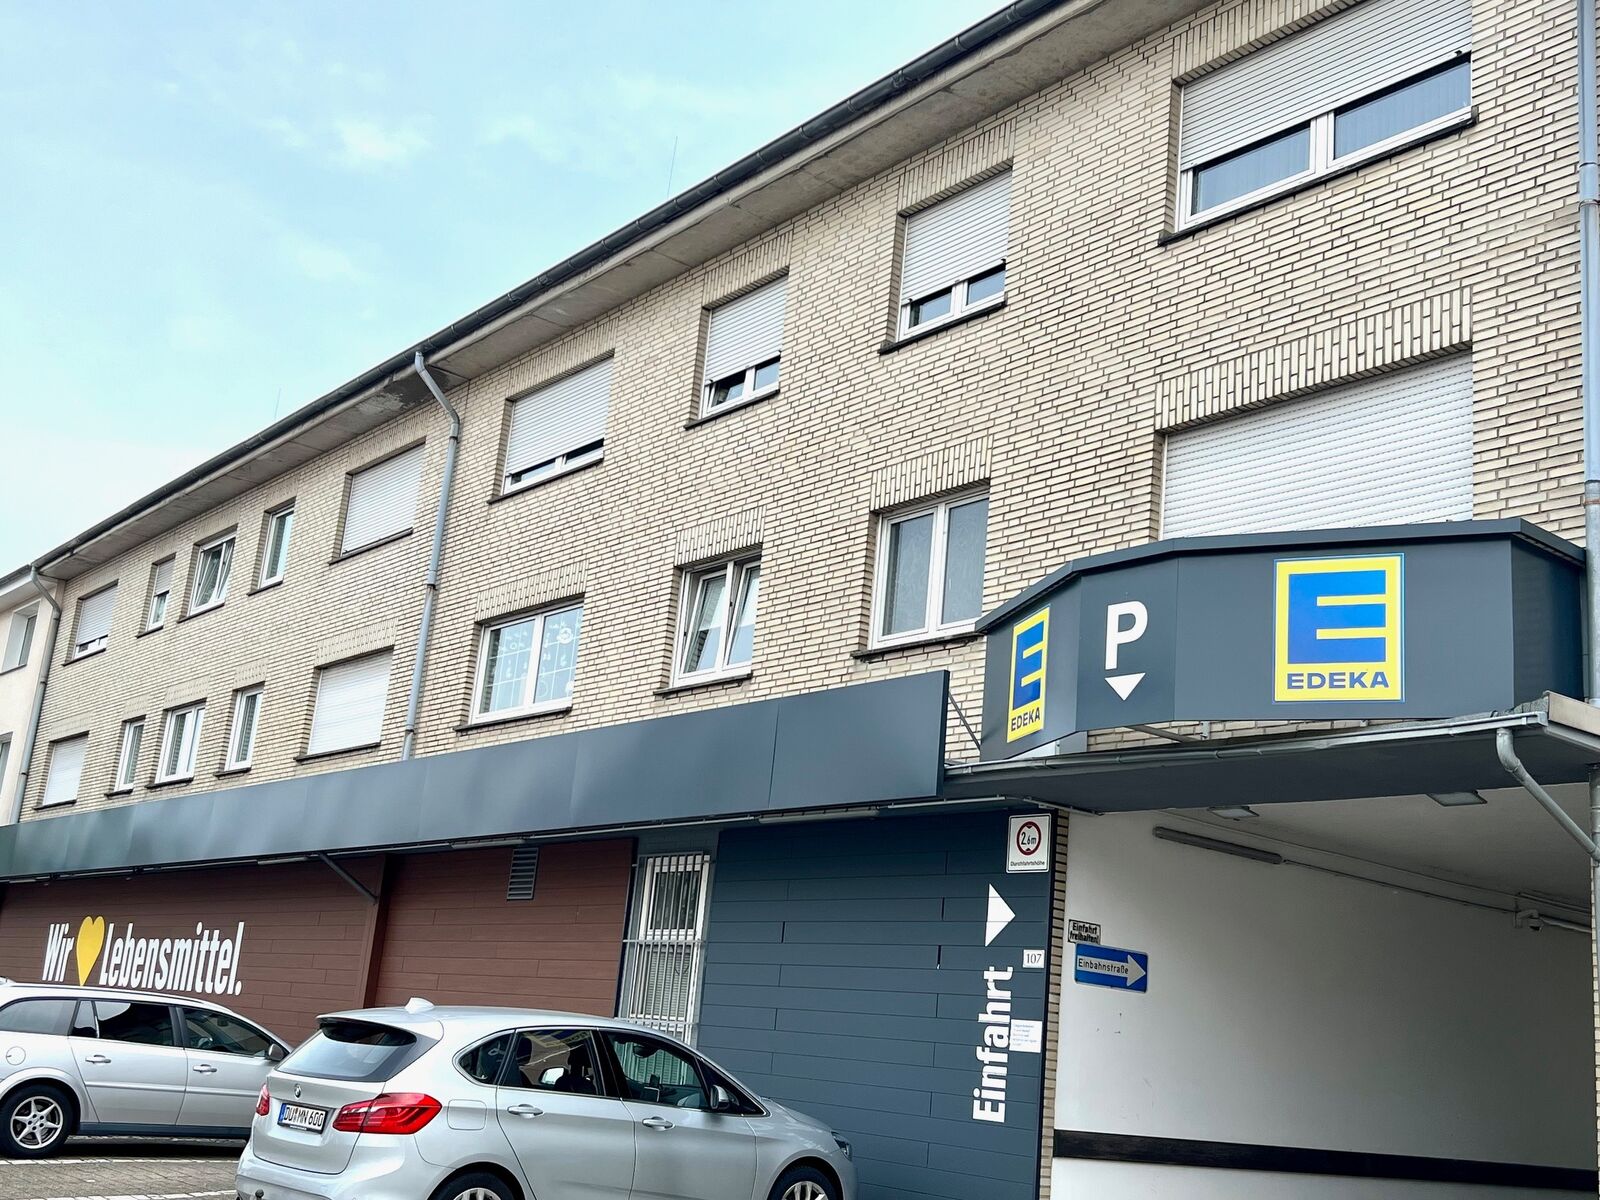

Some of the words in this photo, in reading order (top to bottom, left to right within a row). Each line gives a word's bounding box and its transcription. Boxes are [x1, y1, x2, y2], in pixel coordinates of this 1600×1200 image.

[1105, 601, 1148, 670] P
[1287, 671, 1389, 690] EDEKA
[1011, 707, 1041, 732] EDEKA
[1072, 922, 1097, 934] Einfahrt
[42, 923, 75, 982] Wir
[99, 921, 245, 996] Lebensmittel.
[1026, 953, 1042, 964] 107
[1078, 958, 1129, 975] Einbahnstraße
[972, 966, 1014, 1123] Einfahrt
